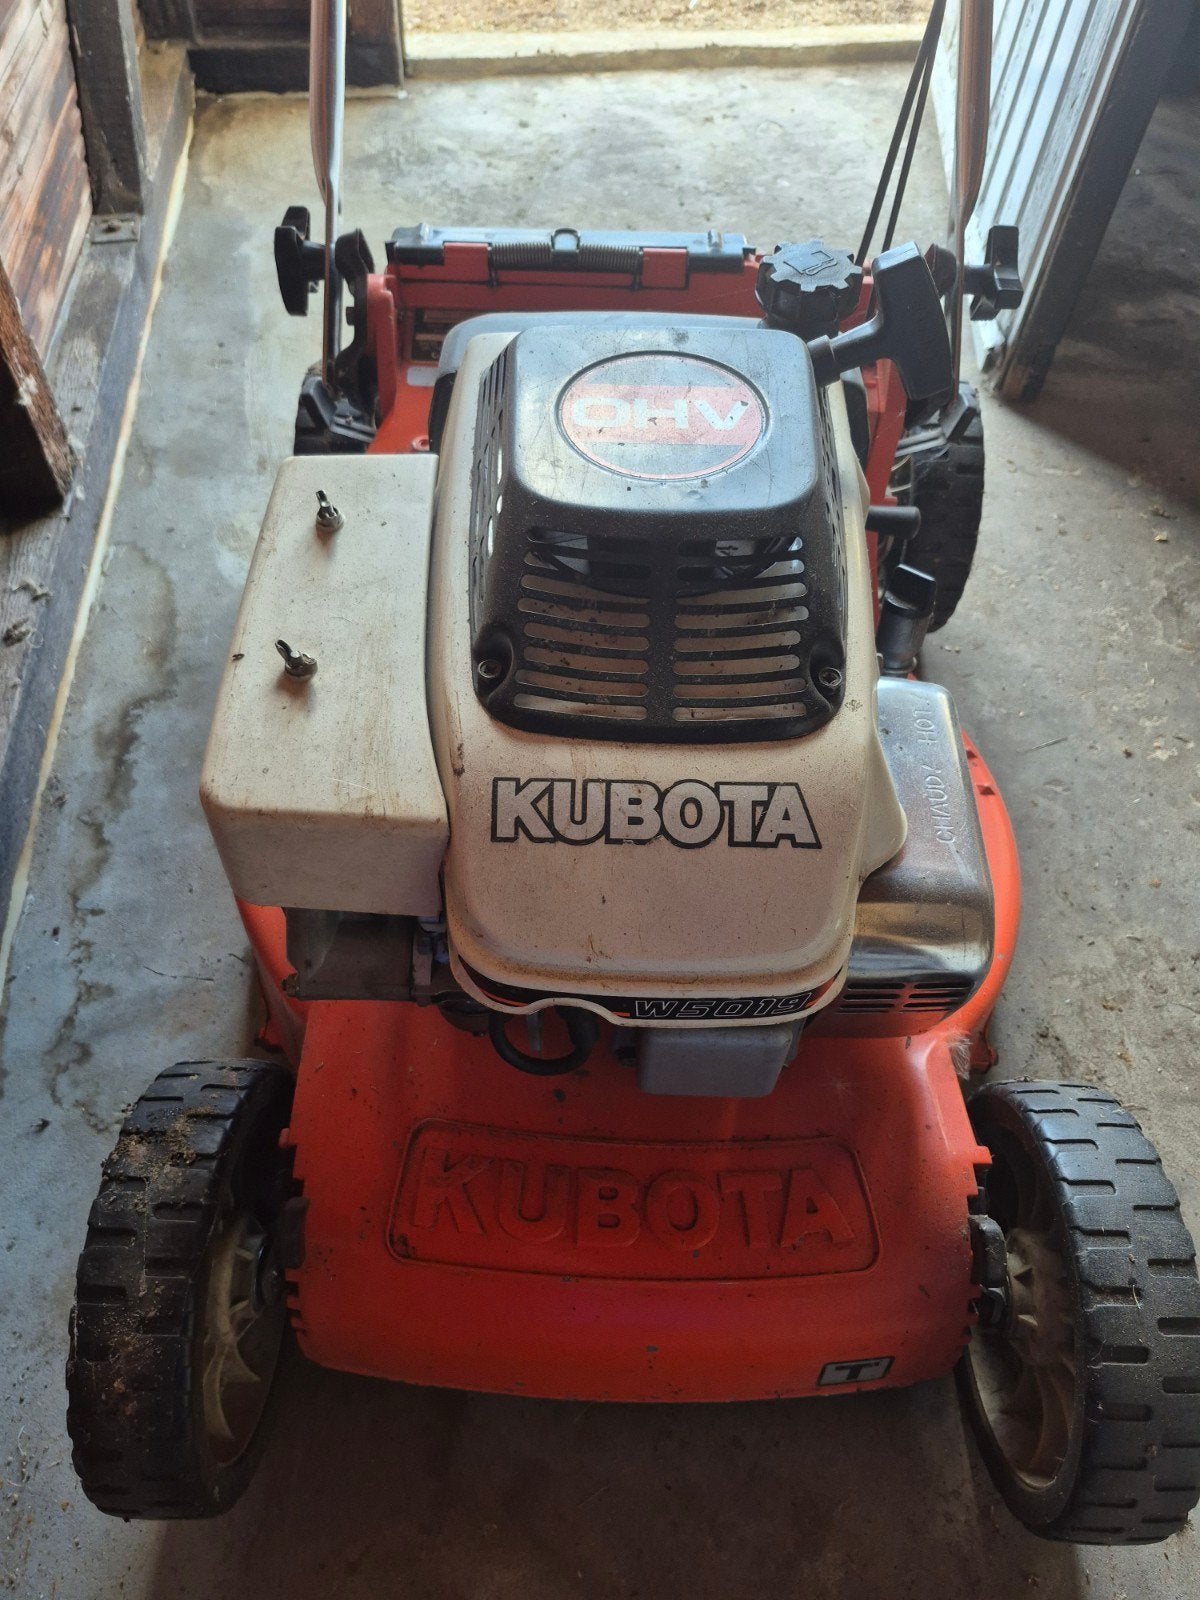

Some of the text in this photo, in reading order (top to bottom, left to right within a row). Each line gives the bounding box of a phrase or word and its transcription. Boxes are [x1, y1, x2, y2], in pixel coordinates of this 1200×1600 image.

[573, 397, 749, 432] OHV
[491, 777, 822, 849] KUBOTA
[635, 992, 813, 1018] W5019
[412, 1148, 855, 1252] KUBOTA
